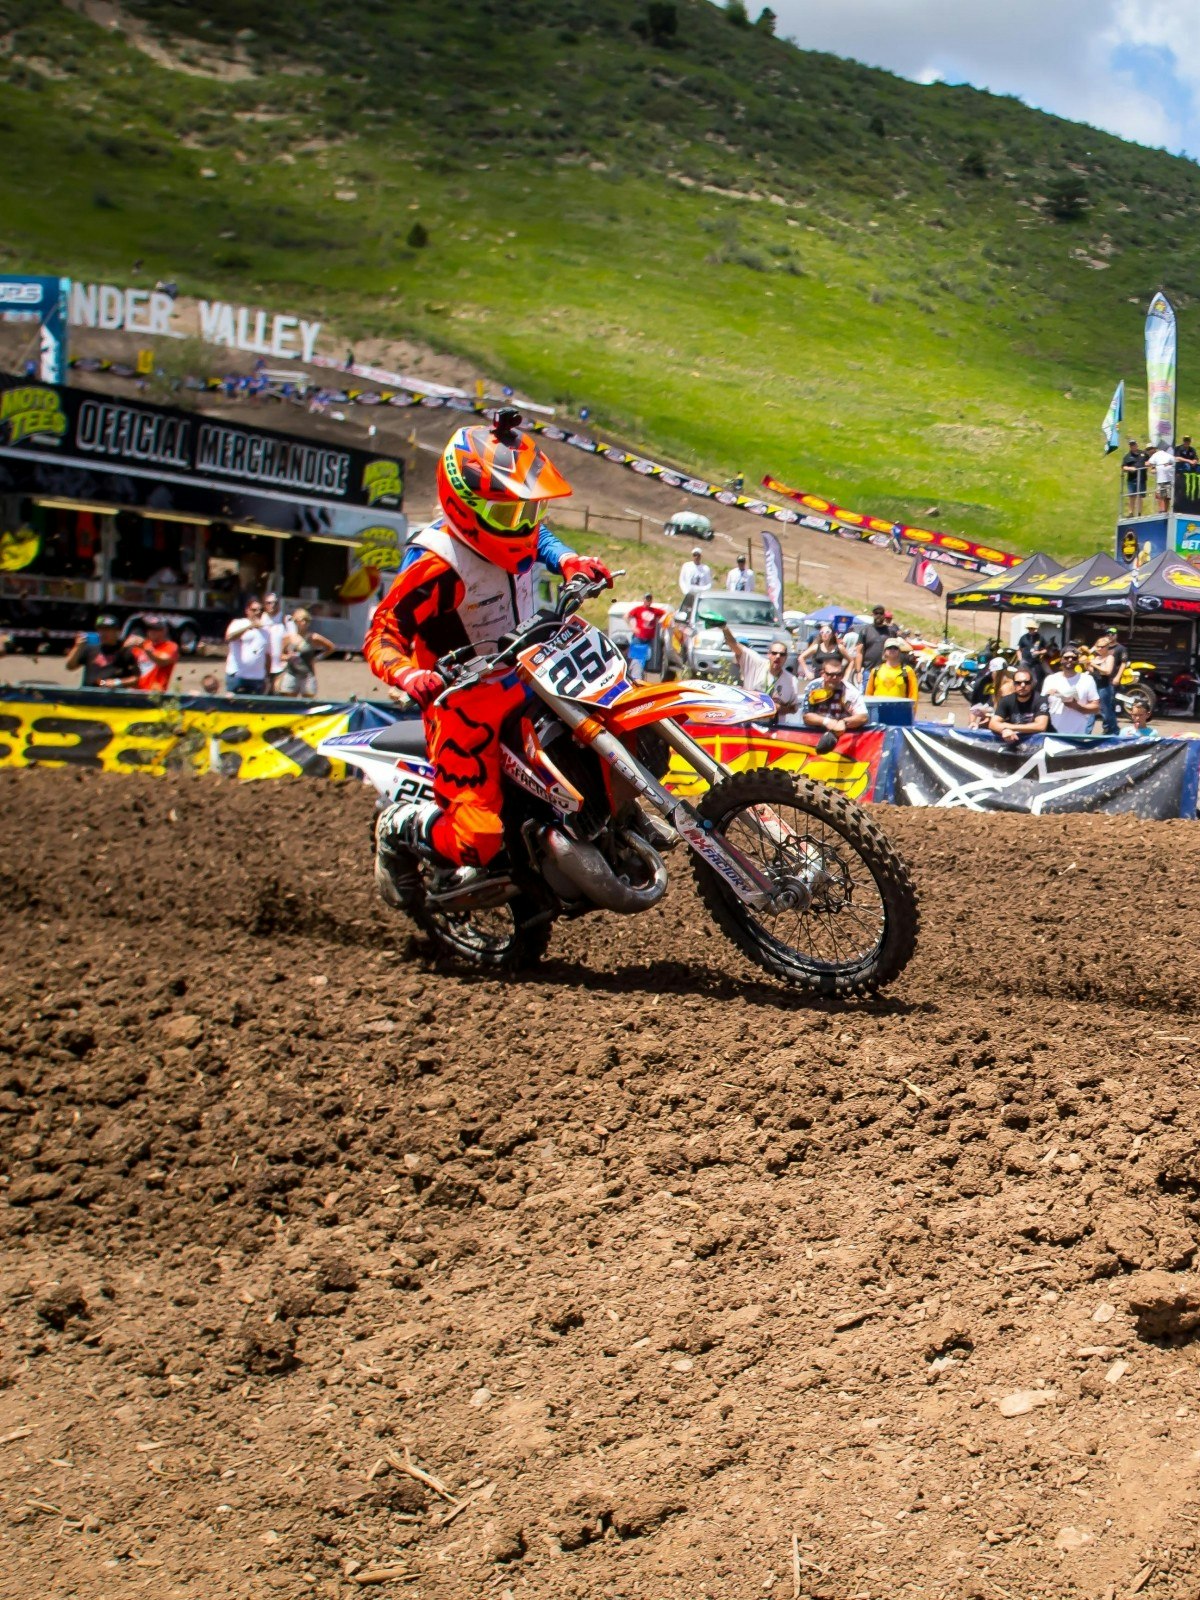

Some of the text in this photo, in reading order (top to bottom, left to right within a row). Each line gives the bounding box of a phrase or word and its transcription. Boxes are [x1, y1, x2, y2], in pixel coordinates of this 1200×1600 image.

[199, 300, 322, 363] VALLEY
[76, 400, 351, 496] OFFICIAL MERCHANDISE
[549, 631, 623, 698] 254
